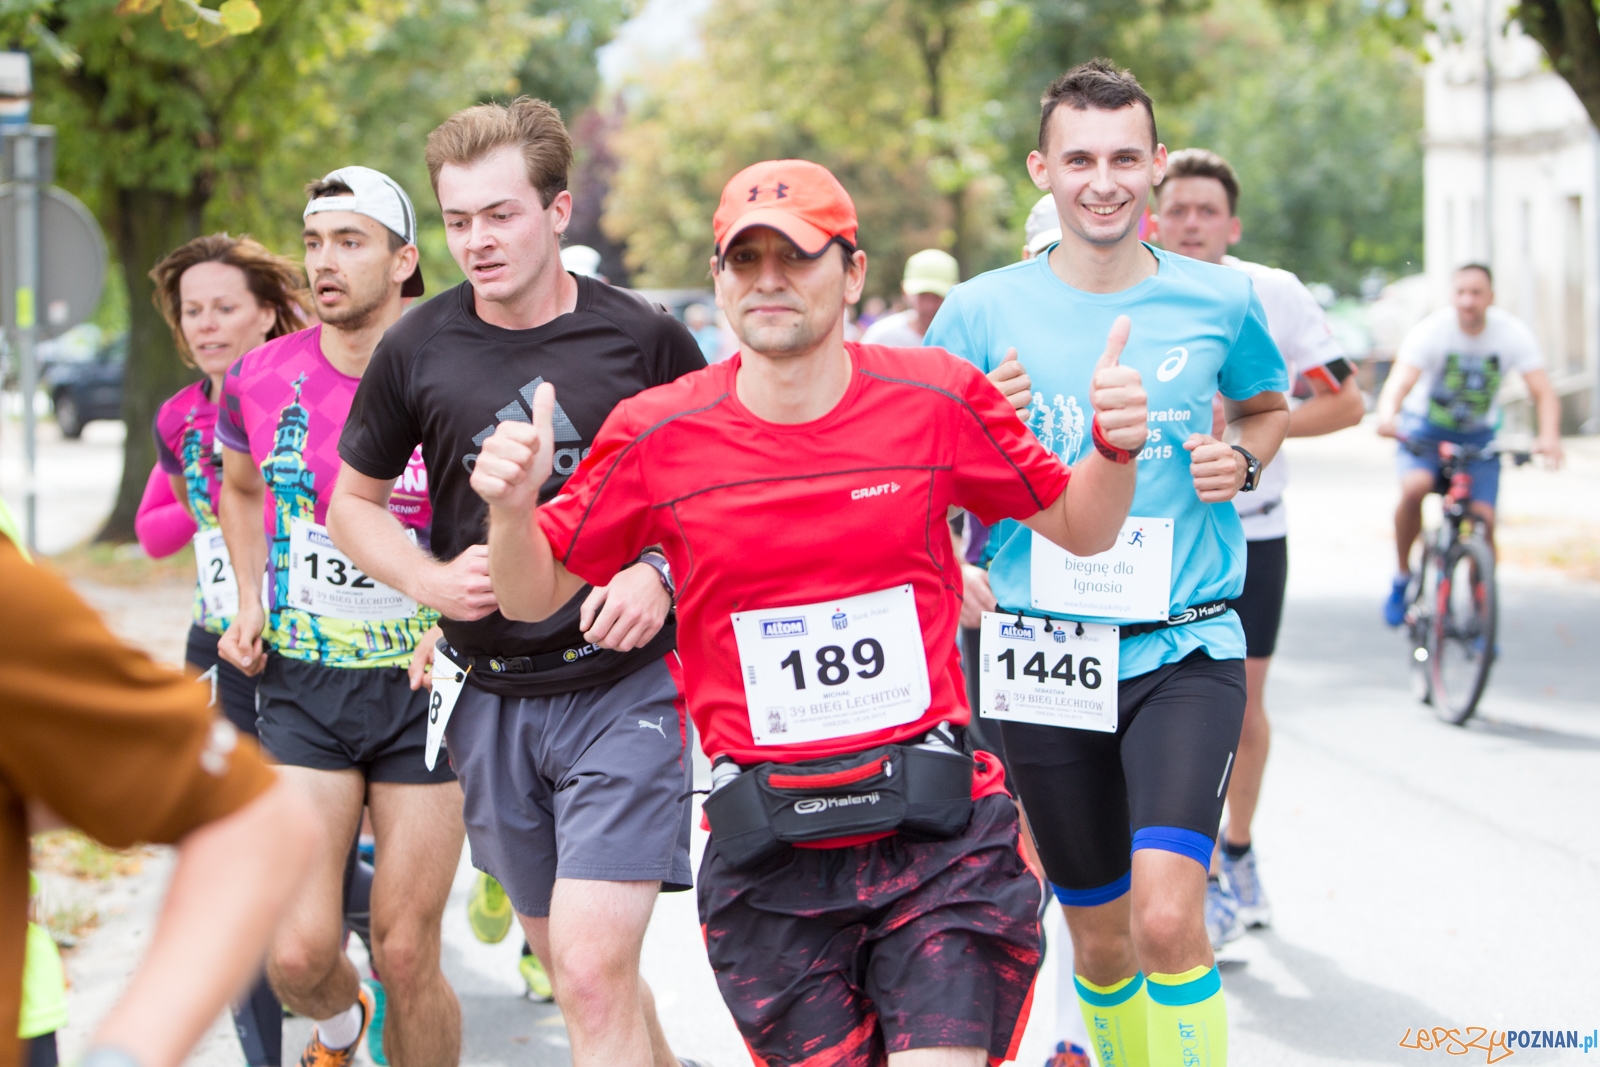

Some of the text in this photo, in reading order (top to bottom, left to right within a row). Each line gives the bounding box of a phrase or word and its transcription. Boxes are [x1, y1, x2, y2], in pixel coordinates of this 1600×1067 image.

[1136, 445, 1173, 460] 2015
[851, 483, 890, 500] CRAFT
[304, 552, 375, 589] 132
[1065, 557, 1134, 577] biegnę dla
[1073, 578, 1123, 595] Ignasia
[329, 593, 352, 604] BIEG
[780, 637, 885, 691] 189
[997, 648, 1102, 690] 1446
[789, 705, 806, 718] 39
[809, 700, 842, 715] BIEG
[846, 683, 911, 709] LECHITÓW
[1013, 692, 1026, 703] 39
[1028, 694, 1052, 705] BIEG
[828, 792, 880, 808] Kalenji
